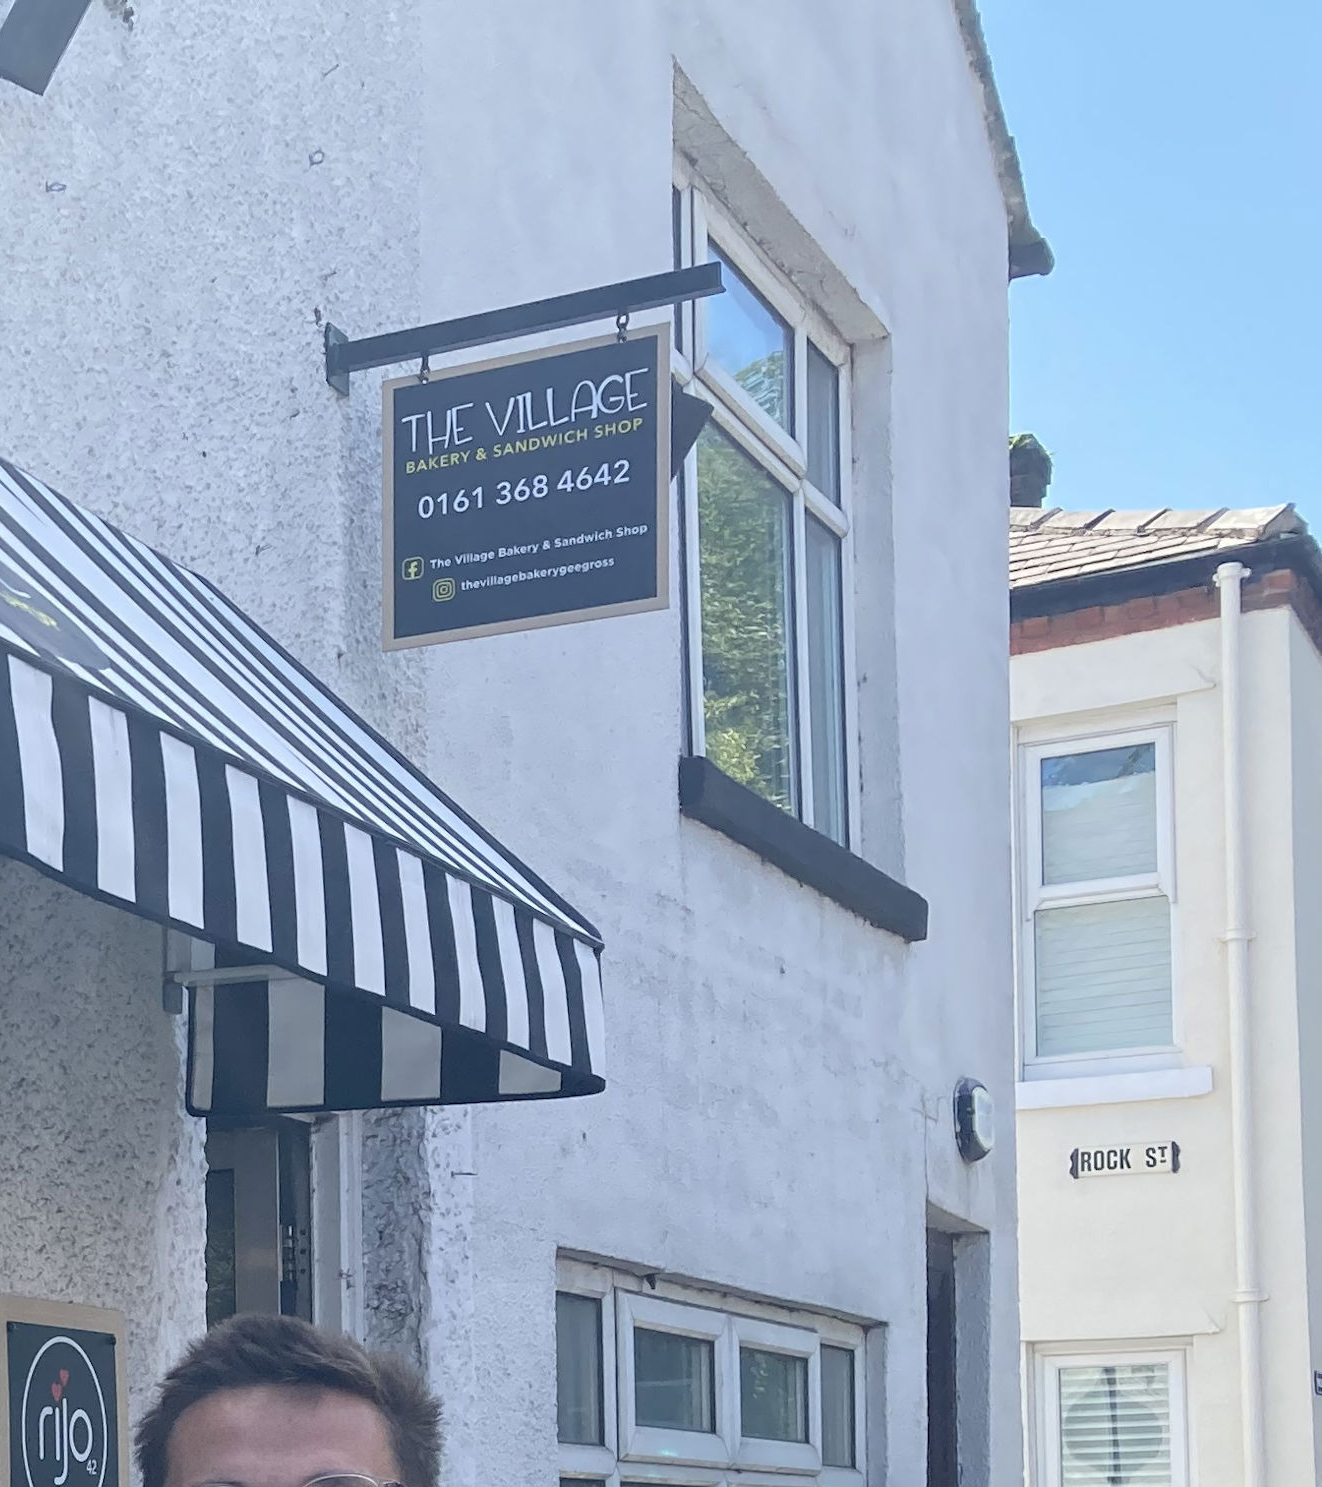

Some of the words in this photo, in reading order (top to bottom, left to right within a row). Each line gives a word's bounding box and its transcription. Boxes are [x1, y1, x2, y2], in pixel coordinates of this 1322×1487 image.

[401, 402, 474, 455] THE
[485, 367, 649, 437] VILLAGE
[405, 448, 472, 475] BAKERY
[475, 447, 488, 462] &
[492, 427, 589, 459] SANDWICH
[593, 416, 644, 440] SHOP
[417, 486, 485, 520] 0161
[495, 474, 549, 506] 368
[557, 459, 630, 494] 4642
[429, 558, 451, 570] The
[454, 551, 495, 566] Village
[498, 543, 539, 558] Bakery
[542, 540, 551, 551] &
[554, 529, 613, 548] Sandwich
[616, 524, 648, 538] Shop
[1080, 1148, 1131, 1172] ROCK
[1145, 1146, 1168, 1168] ST
[38, 1397, 93, 1486] rijo
[86, 1459, 98, 1475] 42
